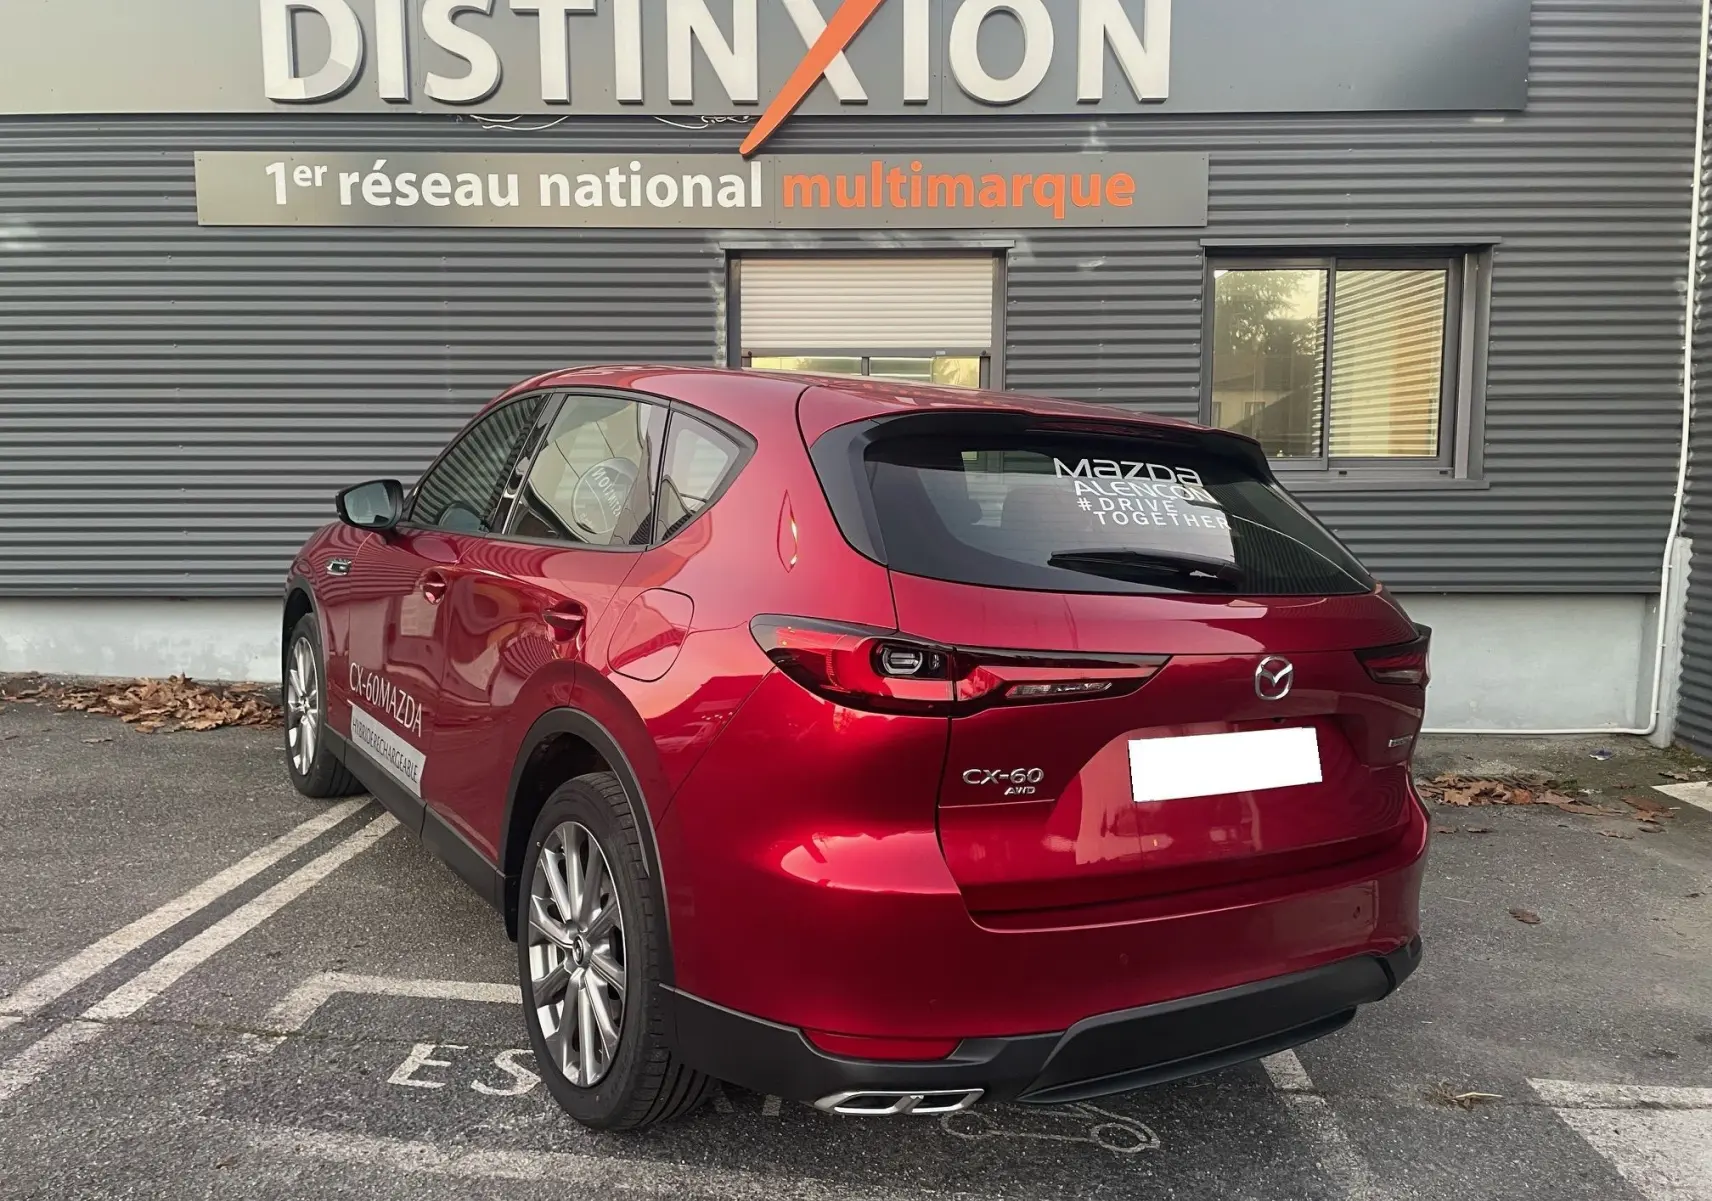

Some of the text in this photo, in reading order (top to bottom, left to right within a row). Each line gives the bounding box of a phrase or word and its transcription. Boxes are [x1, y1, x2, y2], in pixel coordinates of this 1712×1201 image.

[258, 0, 1172, 156] DISTINXION
[264, 159, 1136, 220] 1er réseau national multimarque
[1100, 498, 1178, 514] DRIVE
[1093, 511, 1232, 531] TOGETHER
[962, 767, 1045, 785] CX-60
[1003, 785, 1037, 796] AWD
